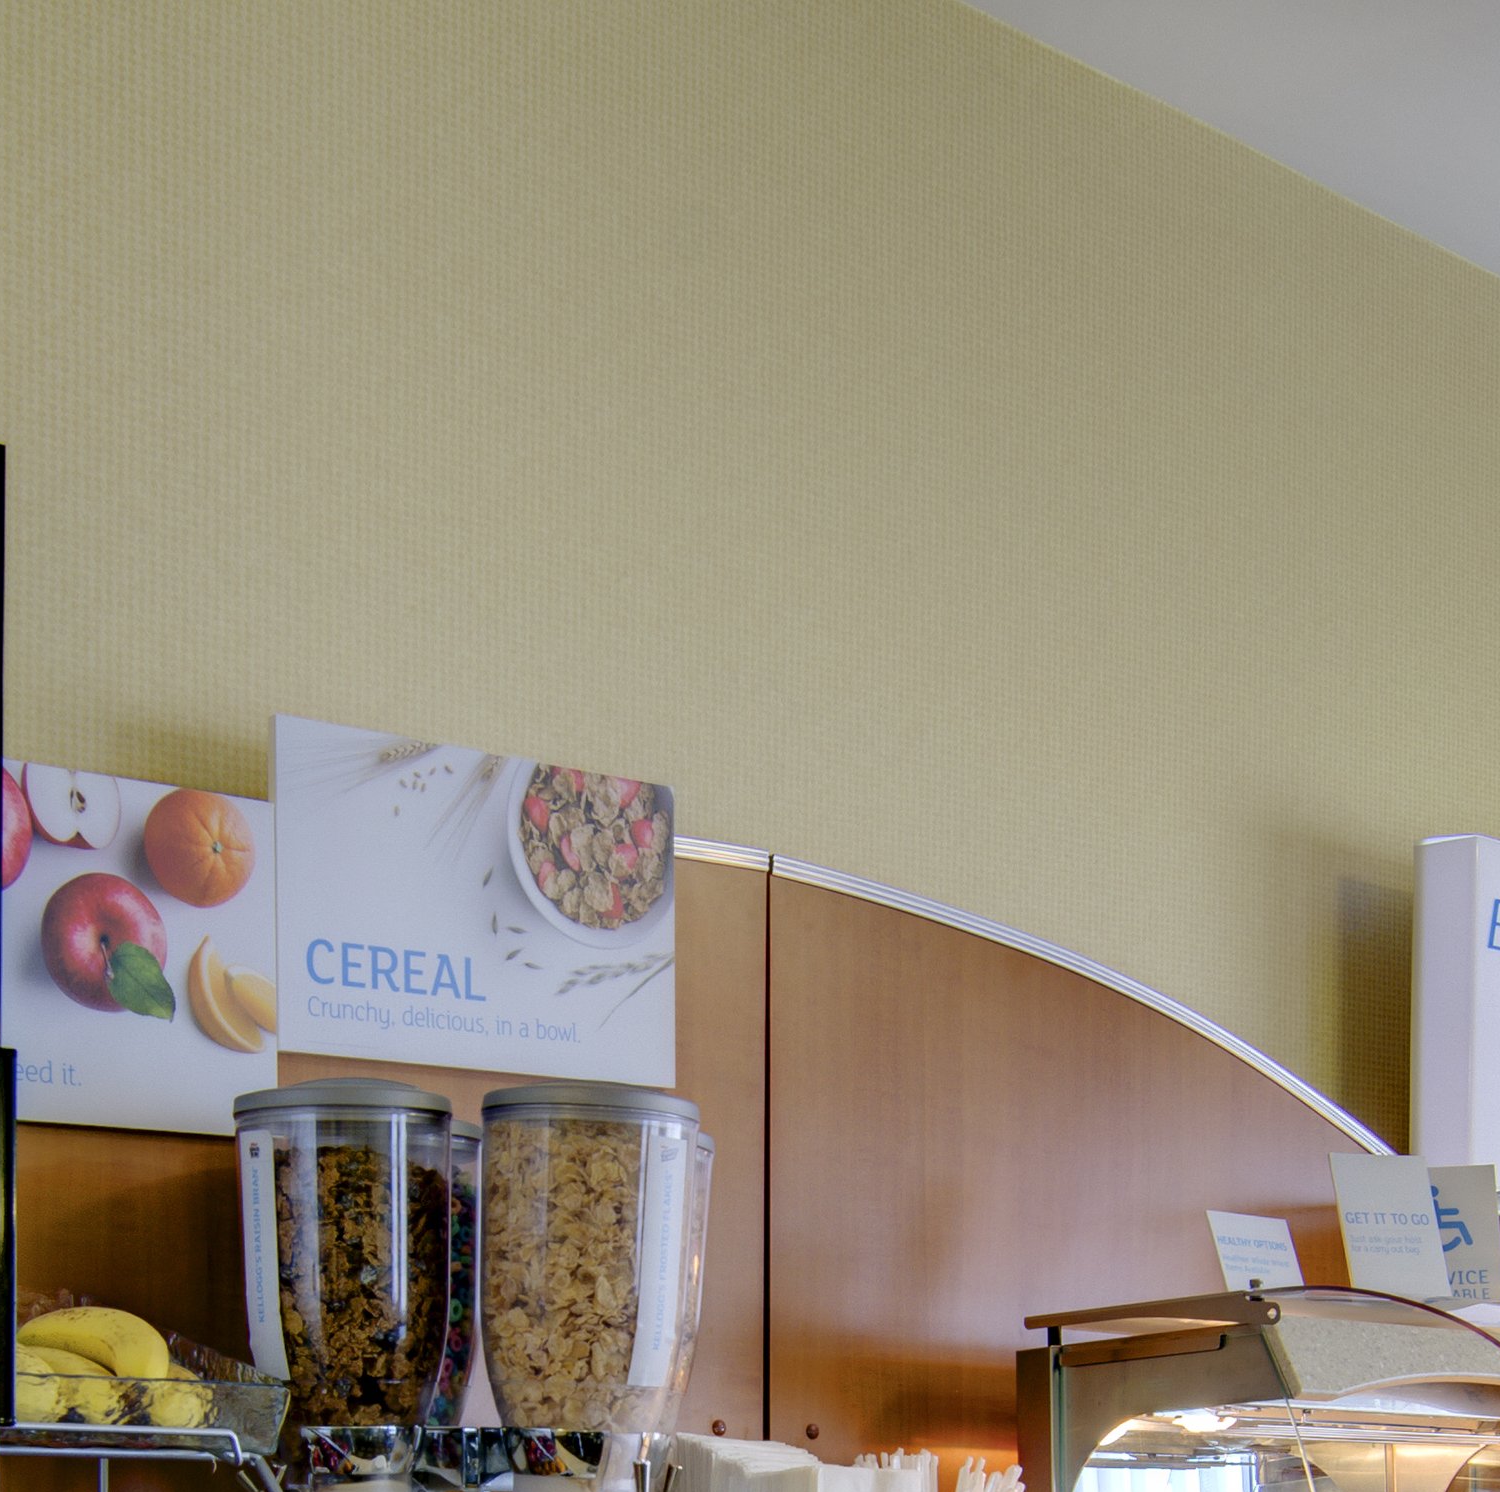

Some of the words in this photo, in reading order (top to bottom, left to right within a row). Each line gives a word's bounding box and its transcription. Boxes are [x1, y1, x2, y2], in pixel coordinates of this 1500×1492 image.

[306, 938, 487, 1001] CEREAL
[307, 995, 395, 1030] Crunchy,
[402, 1004, 489, 1036] delicious,
[496, 1014, 512, 1036] in
[518, 1021, 530, 1038] a
[535, 1018, 582, 1043] bowl.
[14, 1060, 53, 1084] eed
[61, 1063, 82, 1087] it.
[251, 1168, 260, 1205] BRAN
[252, 1208, 262, 1253] RAISIN
[1345, 1211, 1369, 1225] GET
[1374, 1212, 1387, 1225] IT
[1390, 1212, 1408, 1226] TO
[1411, 1213, 1430, 1226] GO
[253, 1255, 264, 1324] KELLOGG'S
[1449, 1269, 1490, 1286] VICE
